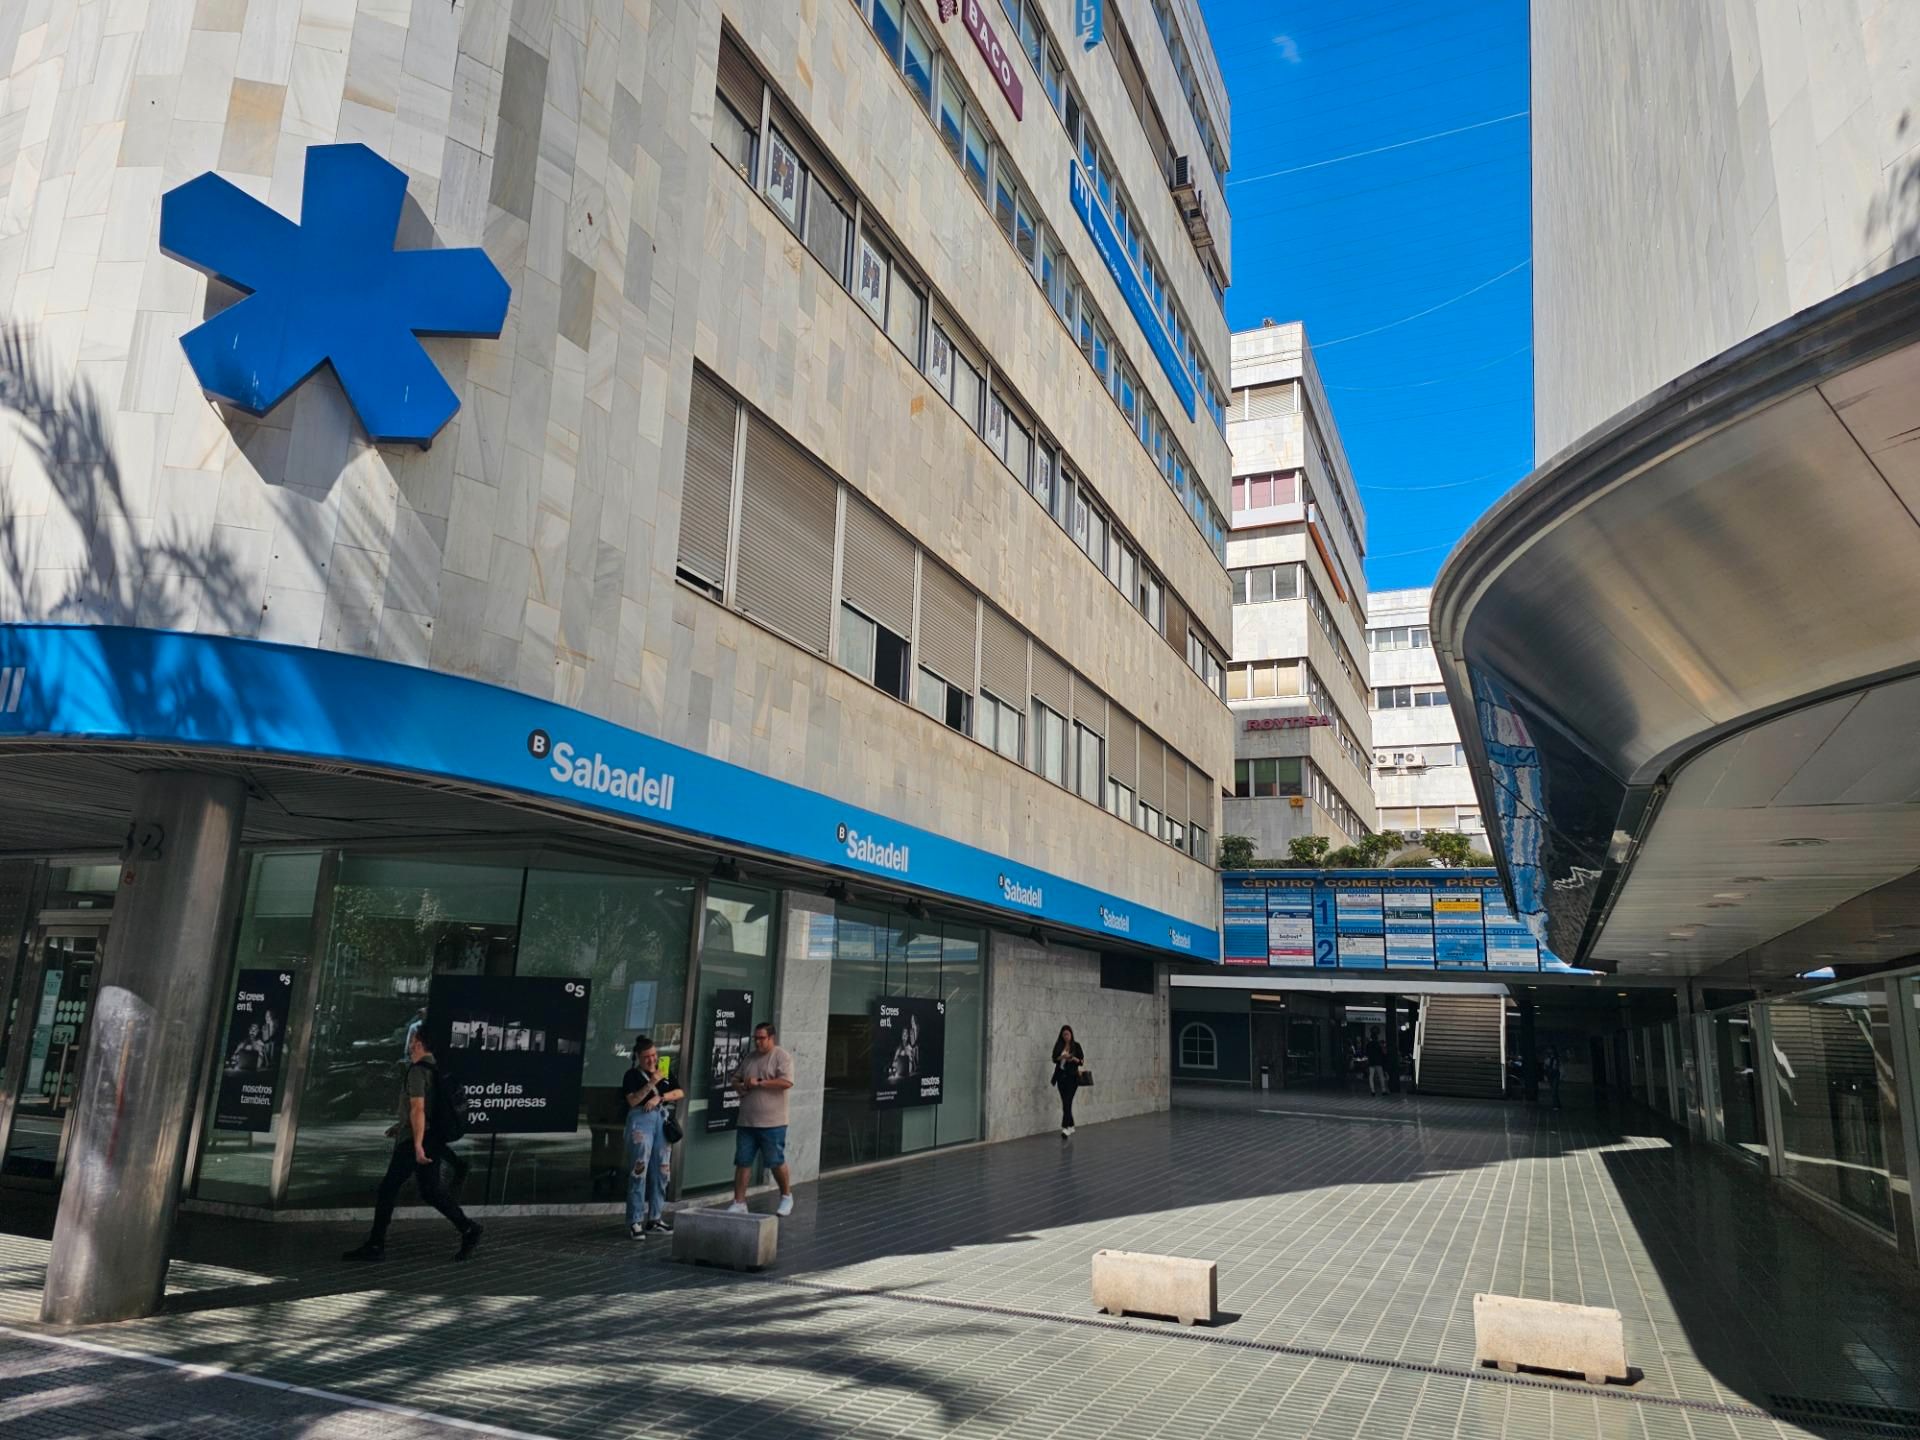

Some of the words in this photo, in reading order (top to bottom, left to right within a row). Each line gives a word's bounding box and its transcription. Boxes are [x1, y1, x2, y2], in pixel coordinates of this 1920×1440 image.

[968, 0, 1011, 88] BACO
[550, 741, 675, 811] Sabadell
[847, 829, 909, 873] Sabadell
[1004, 877, 1042, 909] Sabadell
[1242, 879, 1314, 888] CENTRO
[1325, 878, 1436, 888] COMERCIAL
[1104, 908, 1130, 933] Sabadell
[1316, 900, 1329, 925] 1
[1317, 939, 1335, 965] 2
[242, 1084, 272, 1095] nosotros
[486, 1082, 502, 1095] de
[503, 1082, 524, 1095] las
[483, 1098, 547, 1111] empresas
